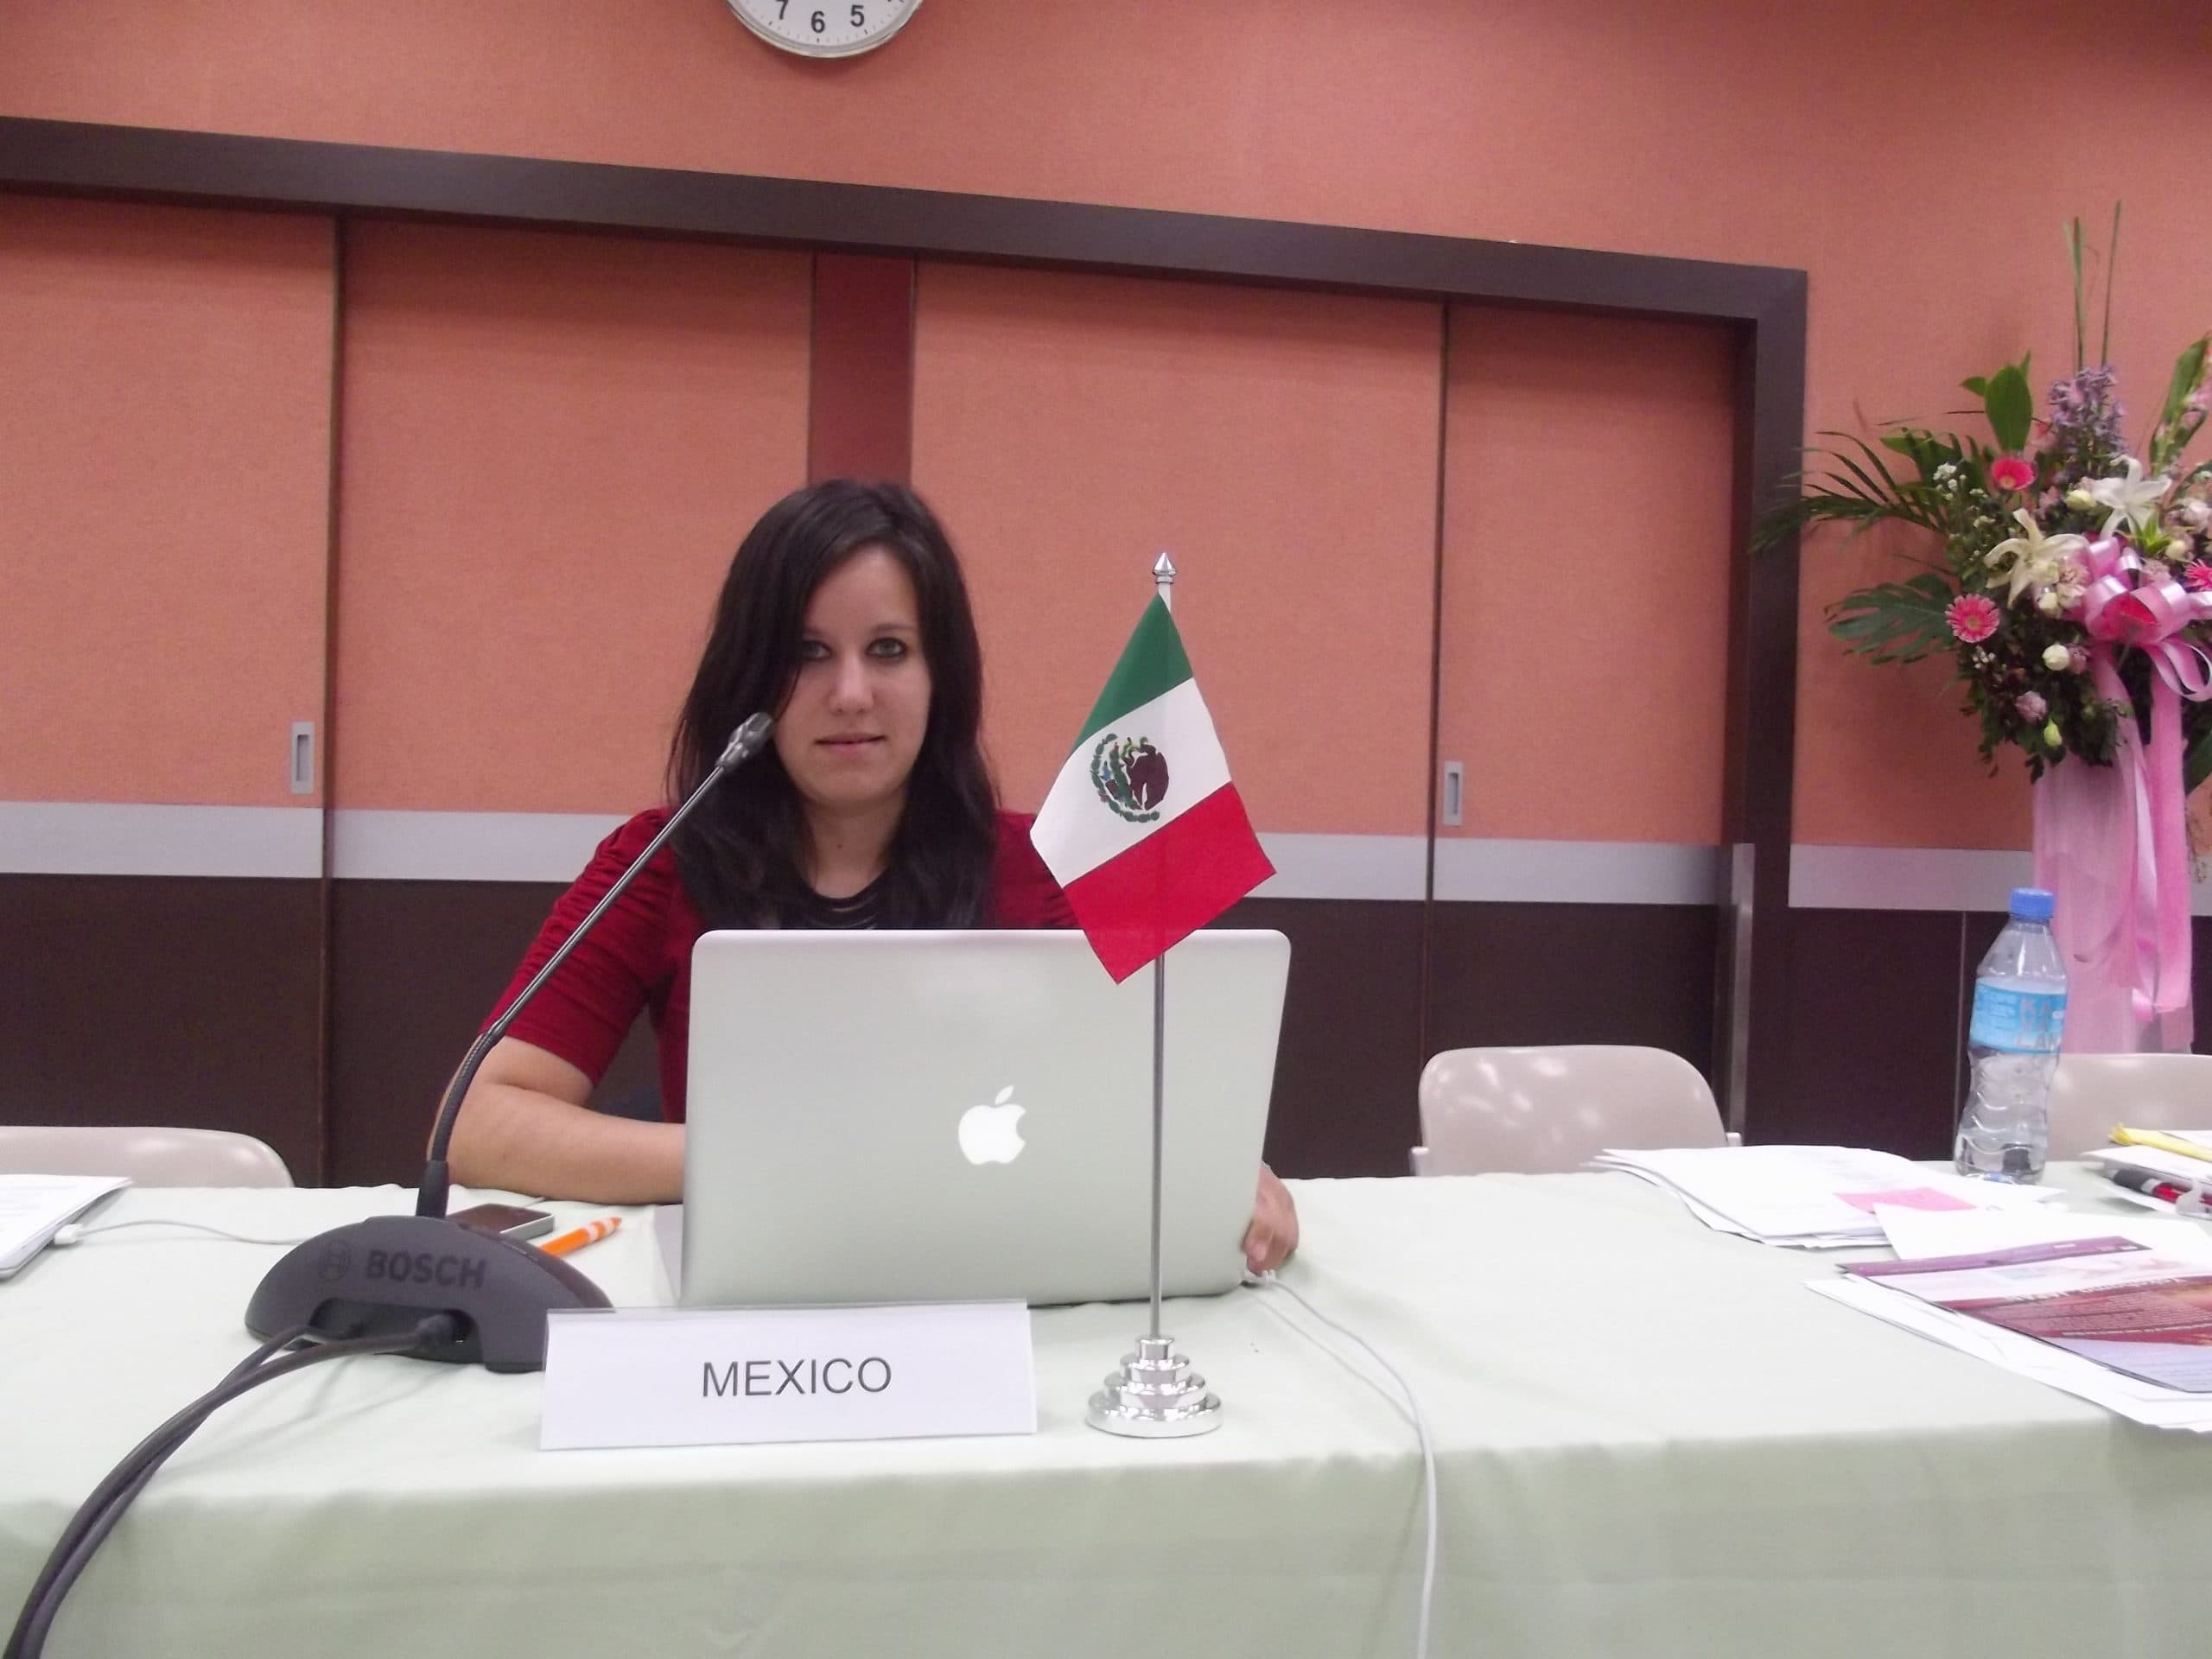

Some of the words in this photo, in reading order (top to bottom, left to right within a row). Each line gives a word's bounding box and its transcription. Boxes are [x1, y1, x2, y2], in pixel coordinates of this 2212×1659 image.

[776, 0, 790, 20] 7
[810, 10, 825, 33] 6
[850, 4, 865, 27] 5
[366, 1249, 486, 1287] BOSCH
[702, 1357, 892, 1397] MEXICO
